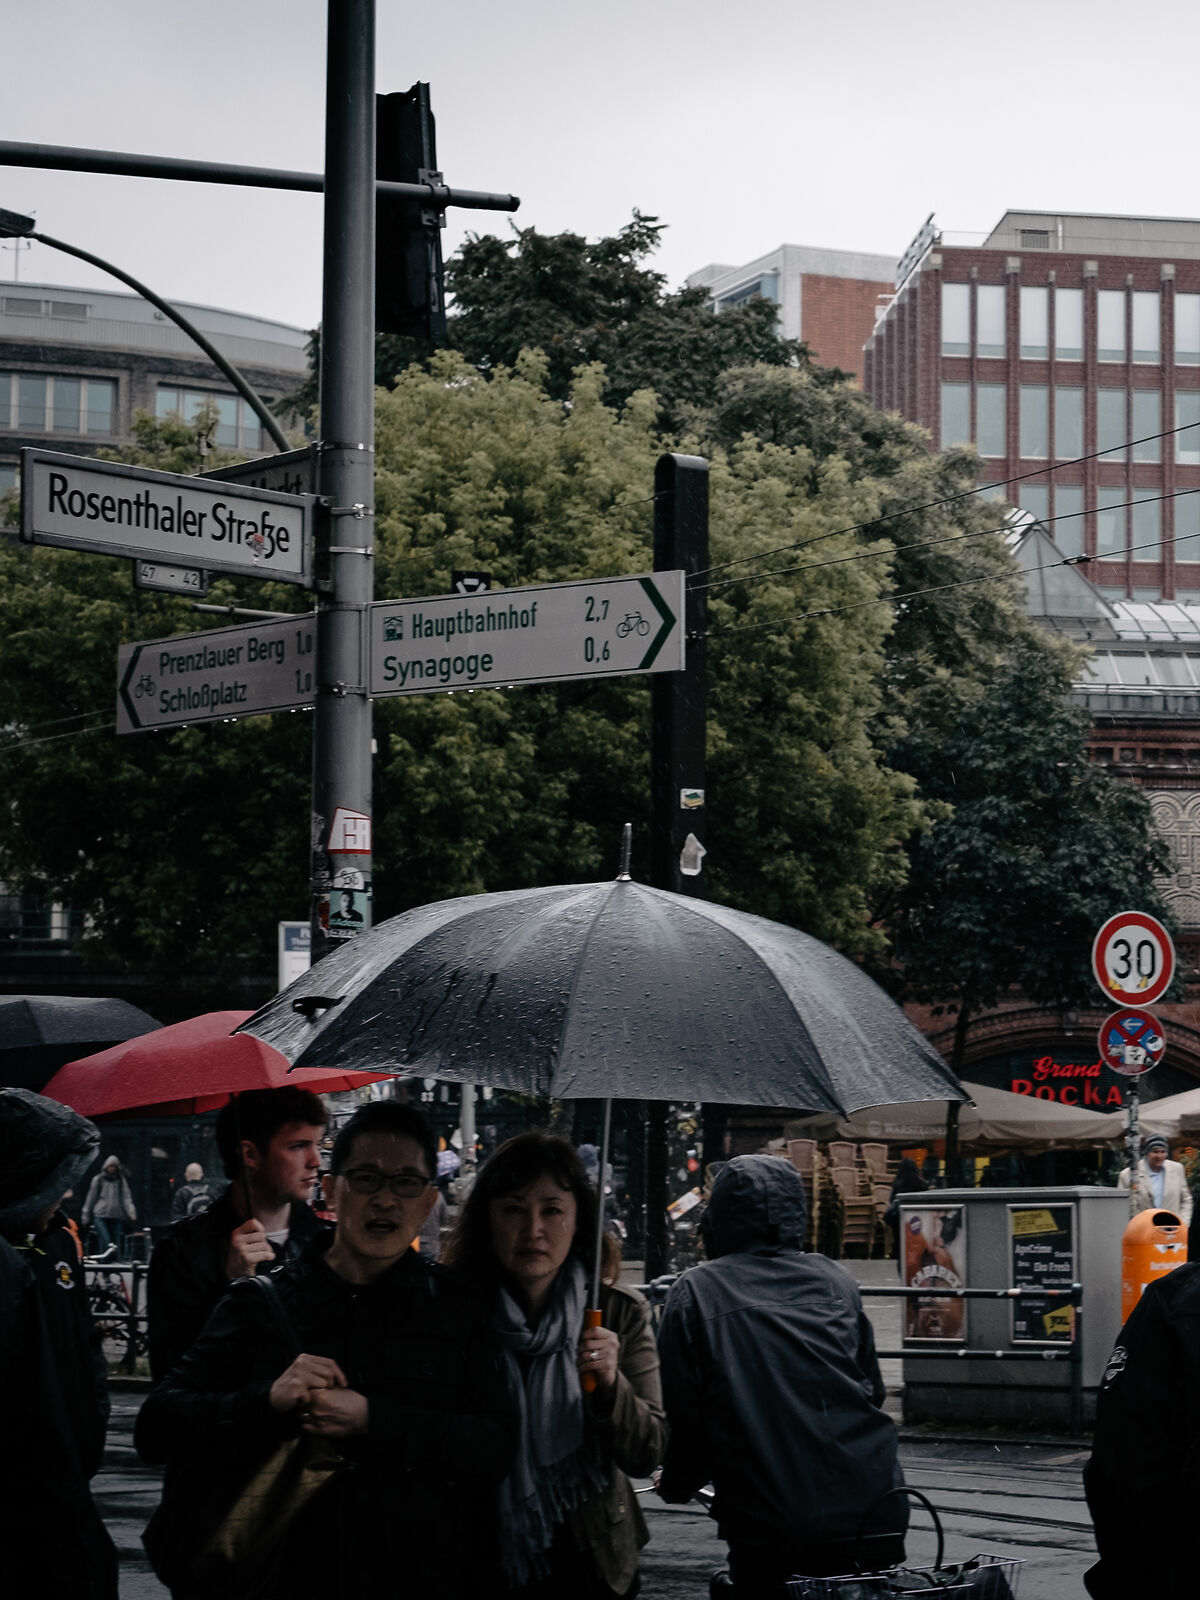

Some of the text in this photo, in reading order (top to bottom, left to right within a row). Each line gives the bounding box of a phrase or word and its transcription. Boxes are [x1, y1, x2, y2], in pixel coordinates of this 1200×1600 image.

[49, 473, 289, 559] Rosenthaler Straße
[140, 566, 155, 579] 47
[183, 572, 199, 585] 42
[412, 596, 610, 642] Hauptbahnhof 2,7
[159, 645, 244, 676] Prenzlauer
[248, 637, 285, 664] Berg
[383, 636, 610, 687] Synagoge 0,6
[159, 681, 248, 714] Schloßplatz
[1113, 939, 1155, 979] 30
[1033, 1056, 1103, 1081] Grand
